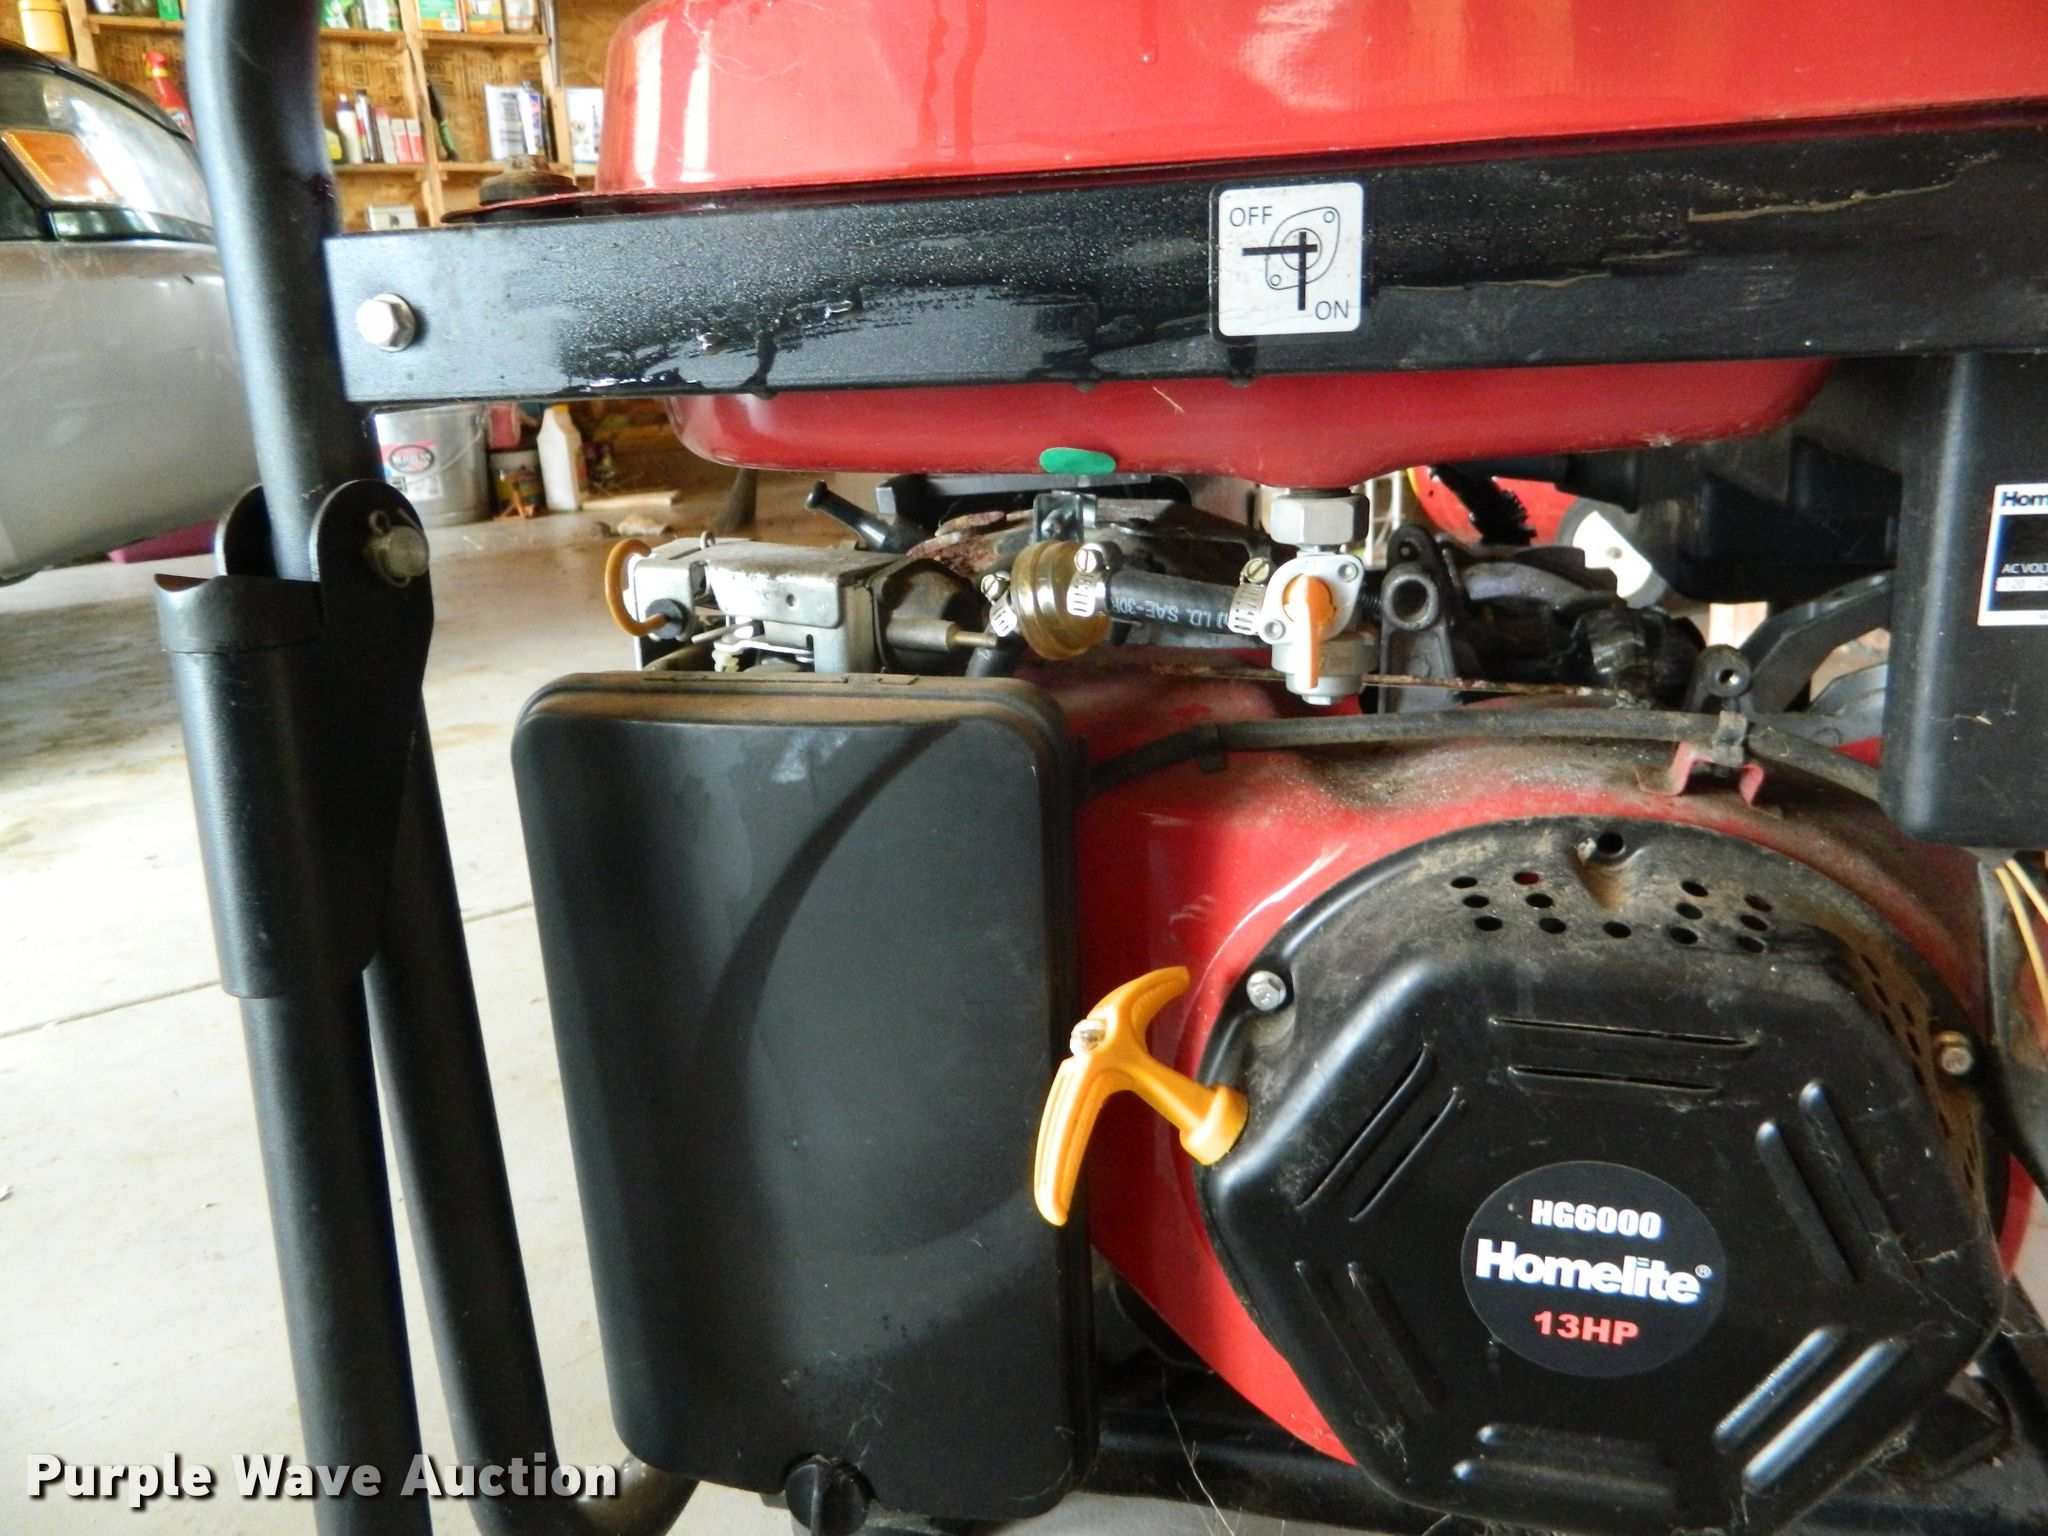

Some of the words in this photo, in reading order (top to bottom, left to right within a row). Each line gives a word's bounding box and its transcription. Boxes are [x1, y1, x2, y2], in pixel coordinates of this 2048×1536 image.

[1229, 205, 1273, 227] OFF
[1315, 300, 1349, 320] ON
[2001, 563, 2020, 574] AC
[1531, 1198, 1663, 1240] HG6000
[1533, 1310, 1640, 1345] 13HP
